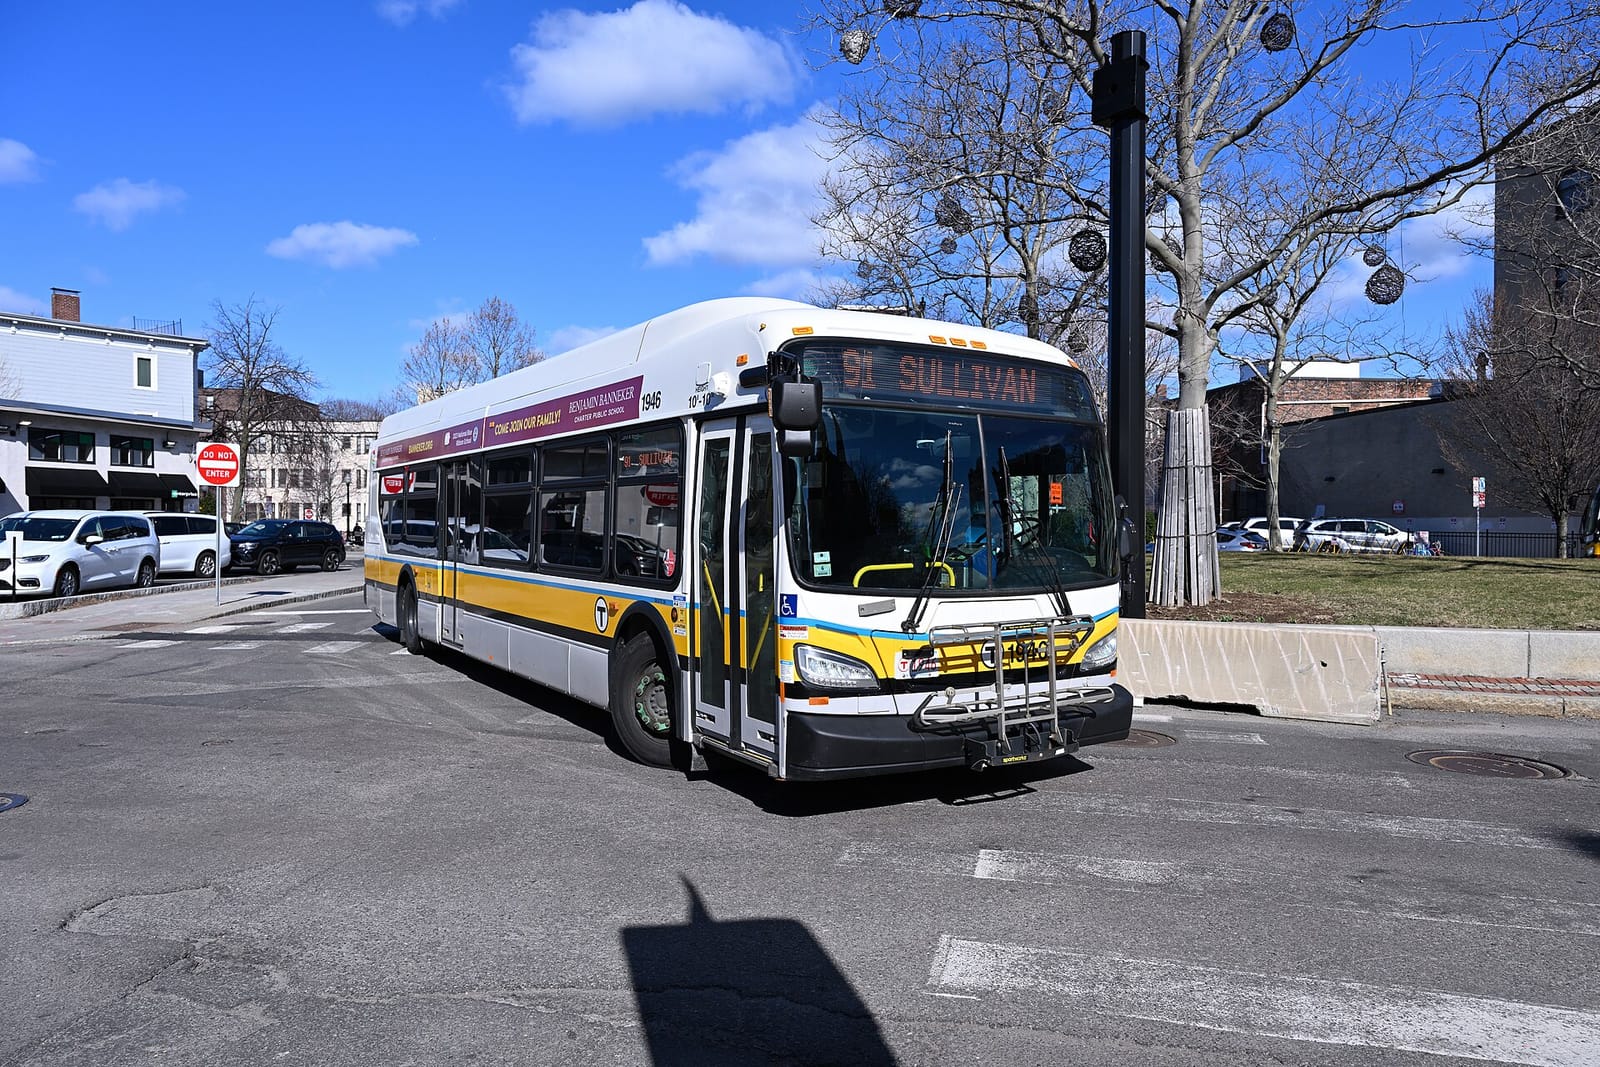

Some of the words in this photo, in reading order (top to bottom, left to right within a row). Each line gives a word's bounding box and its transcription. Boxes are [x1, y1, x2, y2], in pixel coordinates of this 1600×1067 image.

[899, 355, 1036, 403] SULLIVAN
[568, 395, 599, 414] BENJAMIN
[599, 386, 635, 406] BANNEKER
[641, 391, 662, 412] 1946
[509, 418, 523, 433] JOIN
[523, 416, 537, 430] OUR
[537, 409, 561, 427] FAMILY!
[574, 413, 592, 423] CHARTER
[592, 410, 608, 419] PUBLIC
[608, 406, 625, 416] SCHOOL
[203, 451, 214, 459] DO
[206, 469, 230, 478] ENTER
